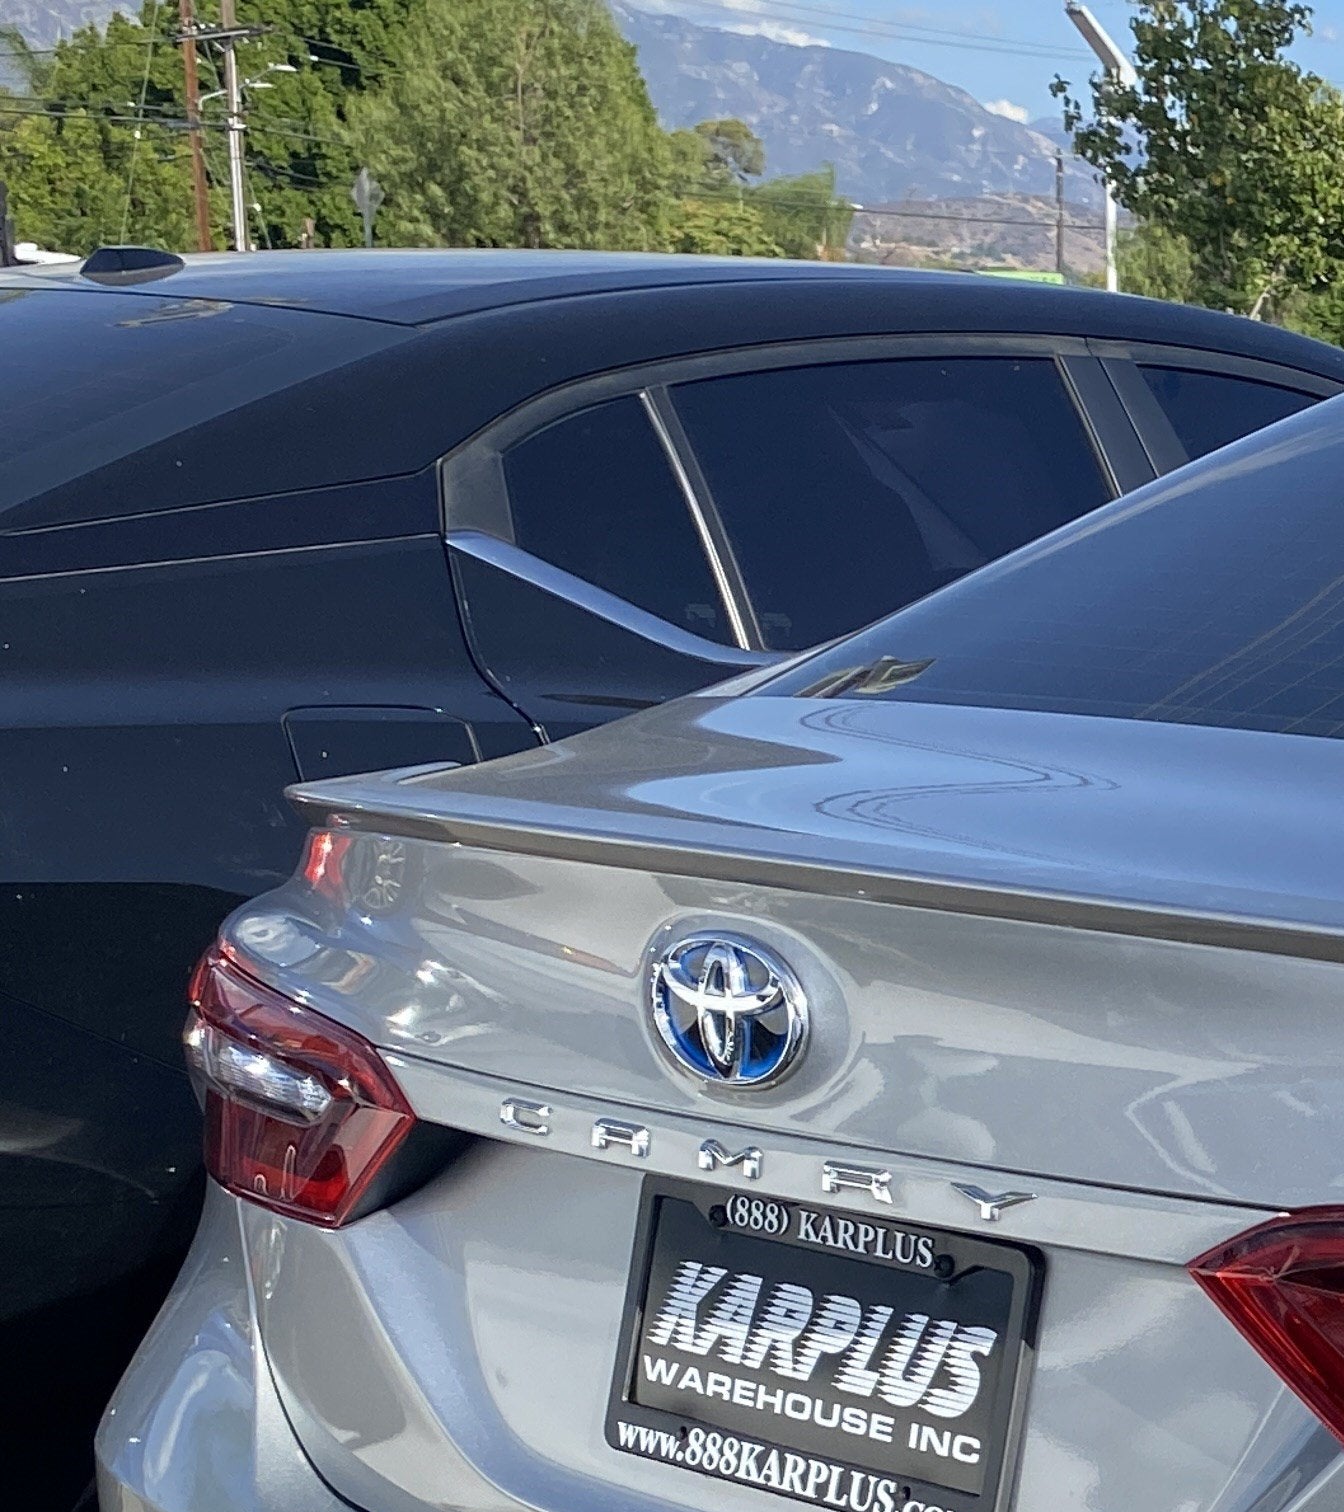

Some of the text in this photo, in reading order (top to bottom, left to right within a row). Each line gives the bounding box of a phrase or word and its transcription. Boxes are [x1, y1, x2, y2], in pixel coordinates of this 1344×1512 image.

[501, 1097, 1038, 1222] CAMRY
[726, 1194, 934, 1268] (888) KARPLUS
[646, 1260, 998, 1419] KARPLUS
[643, 1355, 981, 1464] WAREHOUSE INC
